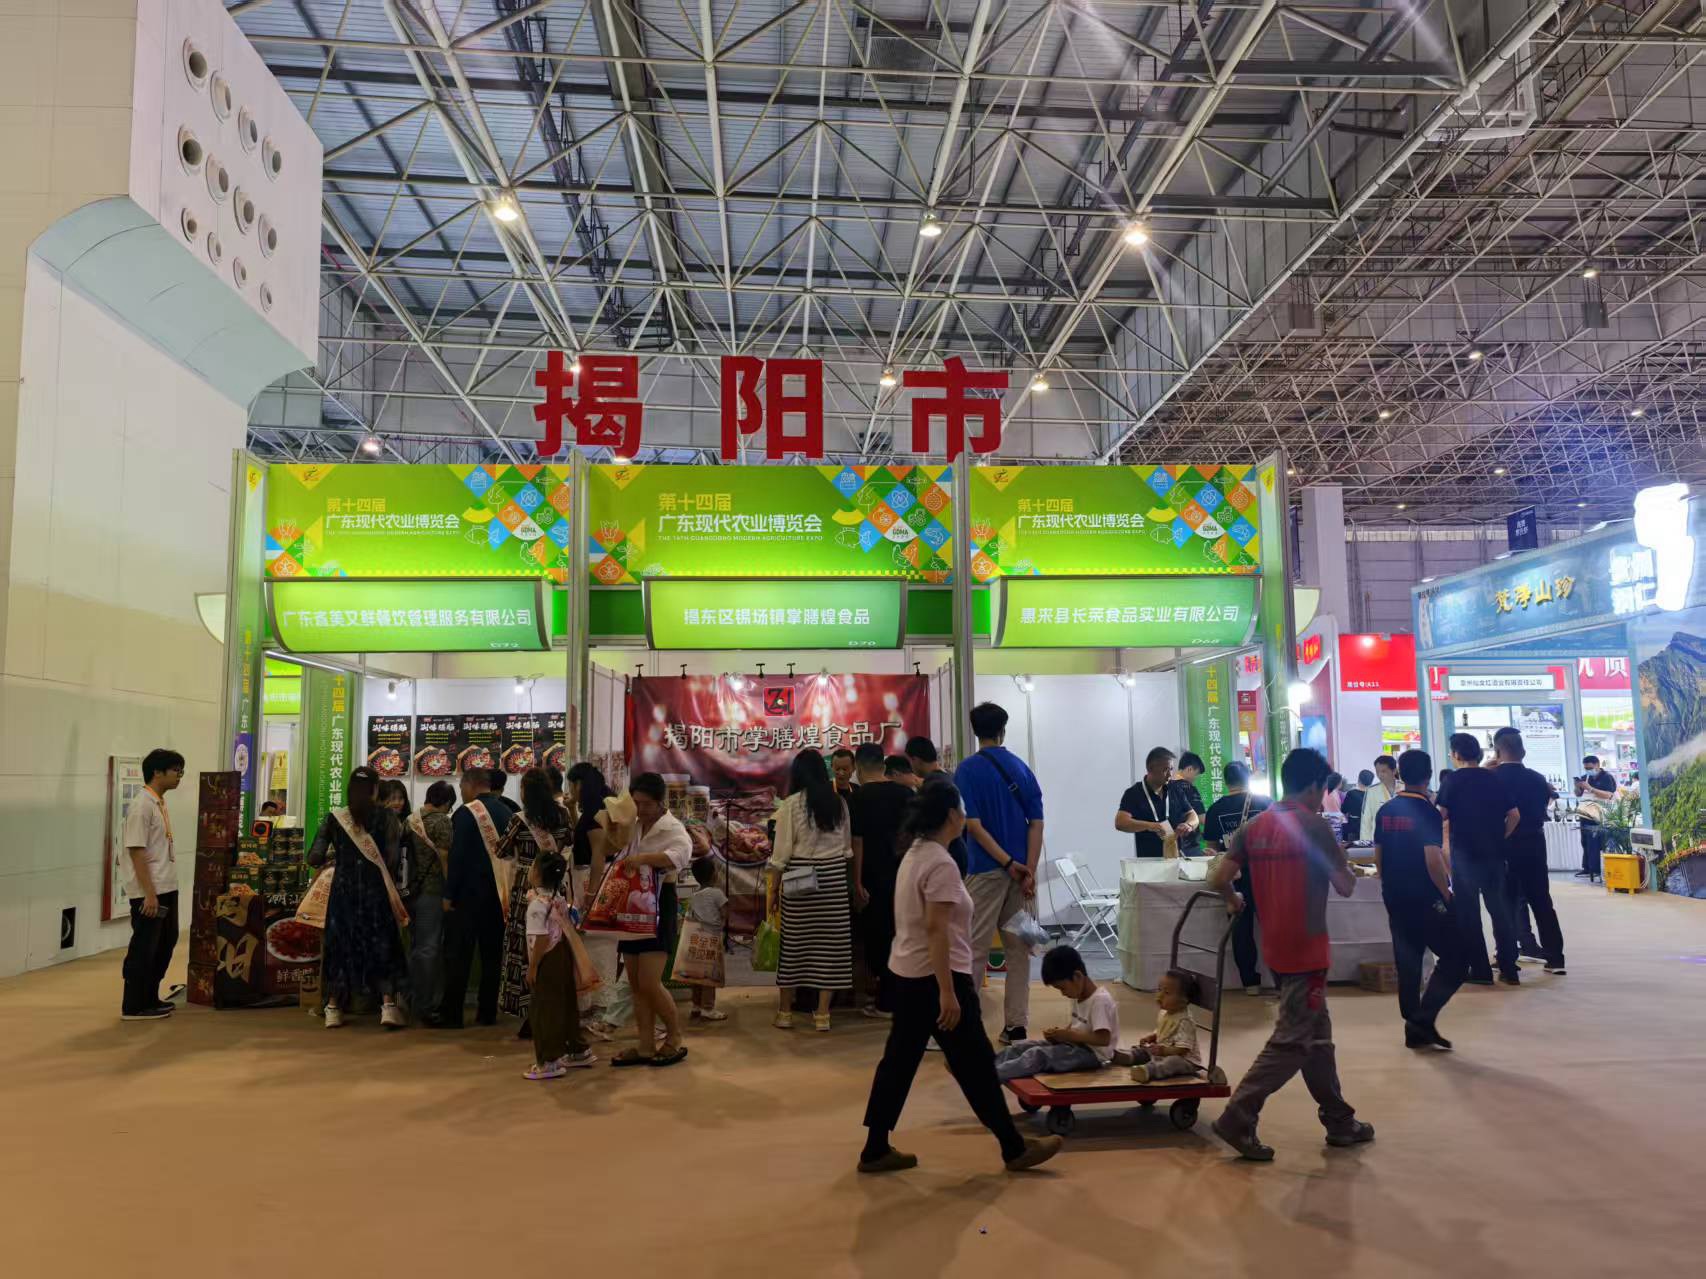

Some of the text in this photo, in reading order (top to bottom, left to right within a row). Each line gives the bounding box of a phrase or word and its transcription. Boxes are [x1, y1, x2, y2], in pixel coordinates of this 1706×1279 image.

[533, 350, 1009, 463] 揭阳市
[327, 498, 386, 512] 第十四届
[659, 493, 732, 511] 第十四届
[1018, 498, 1073, 512] 第十四届
[325, 513, 460, 529] 广东现代农业博览会
[658, 514, 823, 533] 广东现代农业博览会
[1017, 513, 1145, 528] 广东现代农业博览会
[663, 722, 902, 752] 揭阳市掌膳煌食品厂
